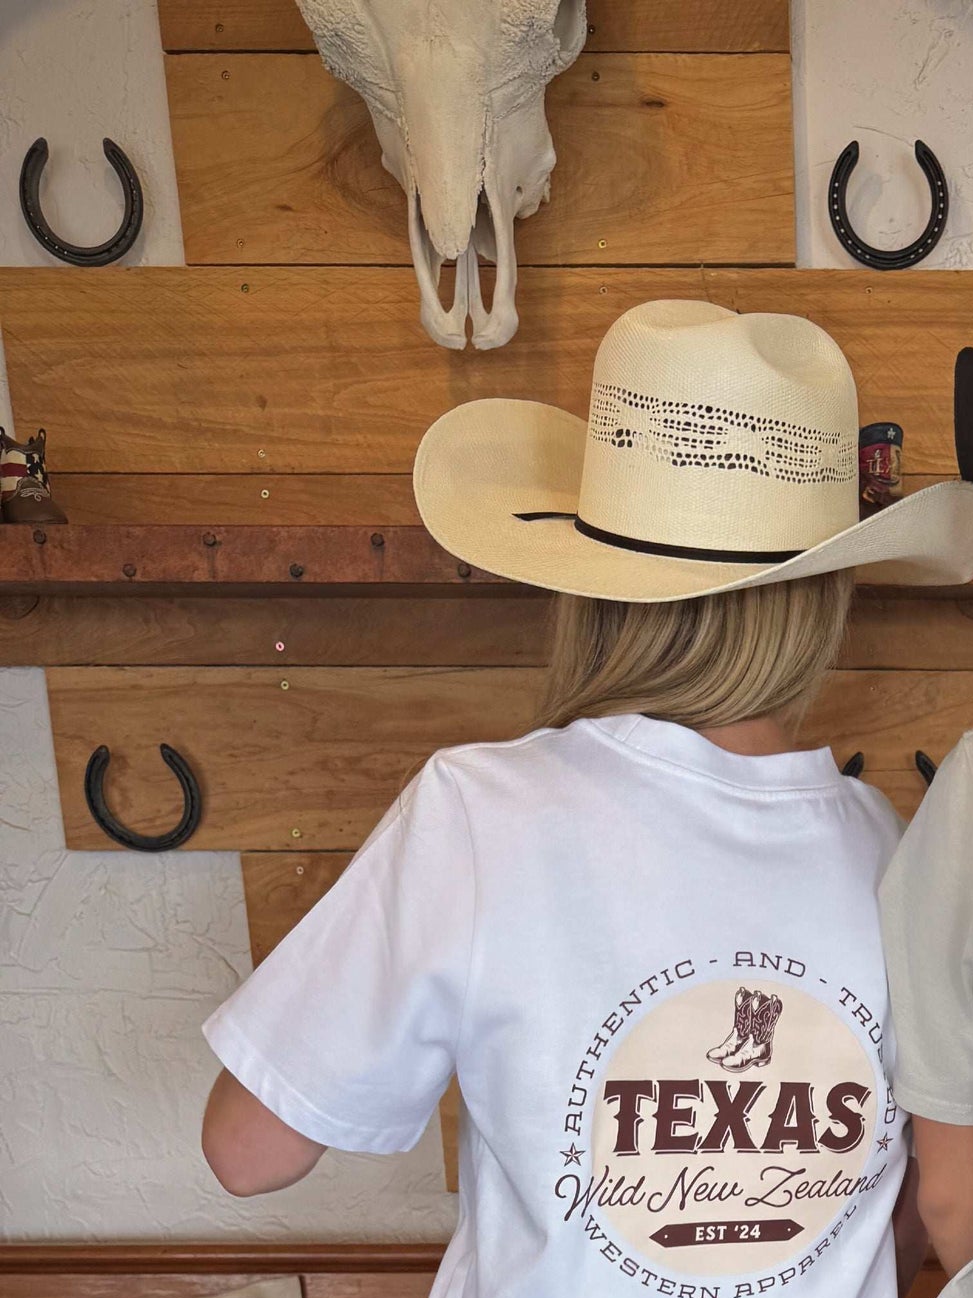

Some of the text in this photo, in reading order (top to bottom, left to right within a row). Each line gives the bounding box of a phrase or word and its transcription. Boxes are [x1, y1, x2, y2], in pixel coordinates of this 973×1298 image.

[564, 958, 696, 1136] AUTHENTIC
[732, 951, 807, 978] AND
[839, 986, 897, 1125] TRUD
[603, 1078, 872, 1157] TEXAS
[554, 1162, 888, 1222] Wild New Zealand
[695, 1225, 728, 1242] EST
[733, 1204, 857, 1298] APPAREL
